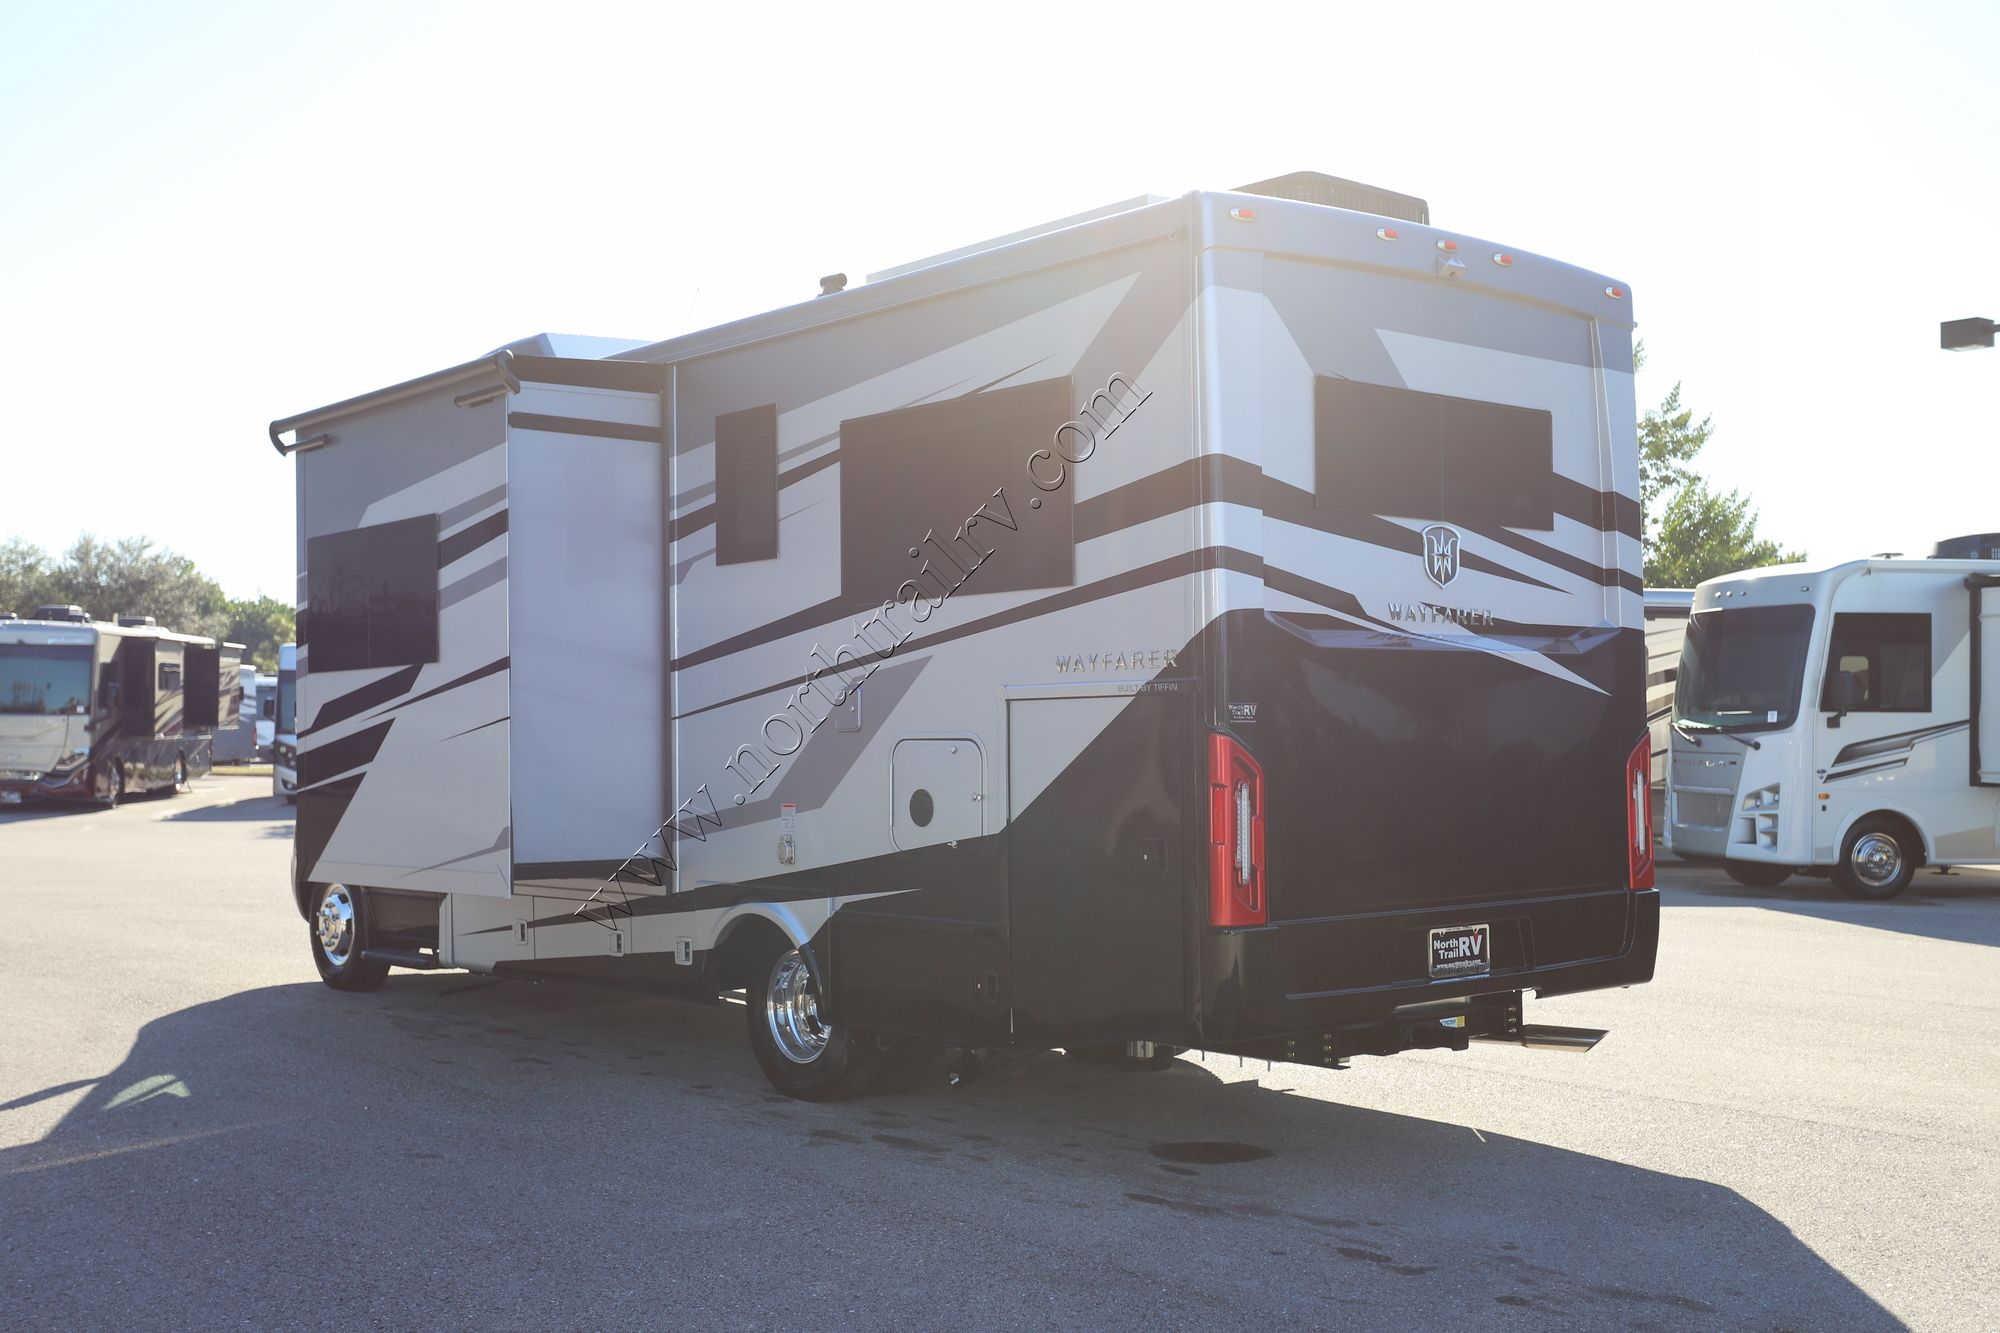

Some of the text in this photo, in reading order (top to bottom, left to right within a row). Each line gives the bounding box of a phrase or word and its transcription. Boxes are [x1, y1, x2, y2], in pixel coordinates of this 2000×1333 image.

[1387, 602, 1494, 626] WAYFARER
[1055, 649, 1177, 673] WAYFARER
[1153, 682, 1178, 691] TIFFIN
[1243, 704, 1256, 716] RV
[1433, 938, 1459, 950] North
[1459, 935, 1482, 957] RV
[1438, 948, 1459, 960] Trail
